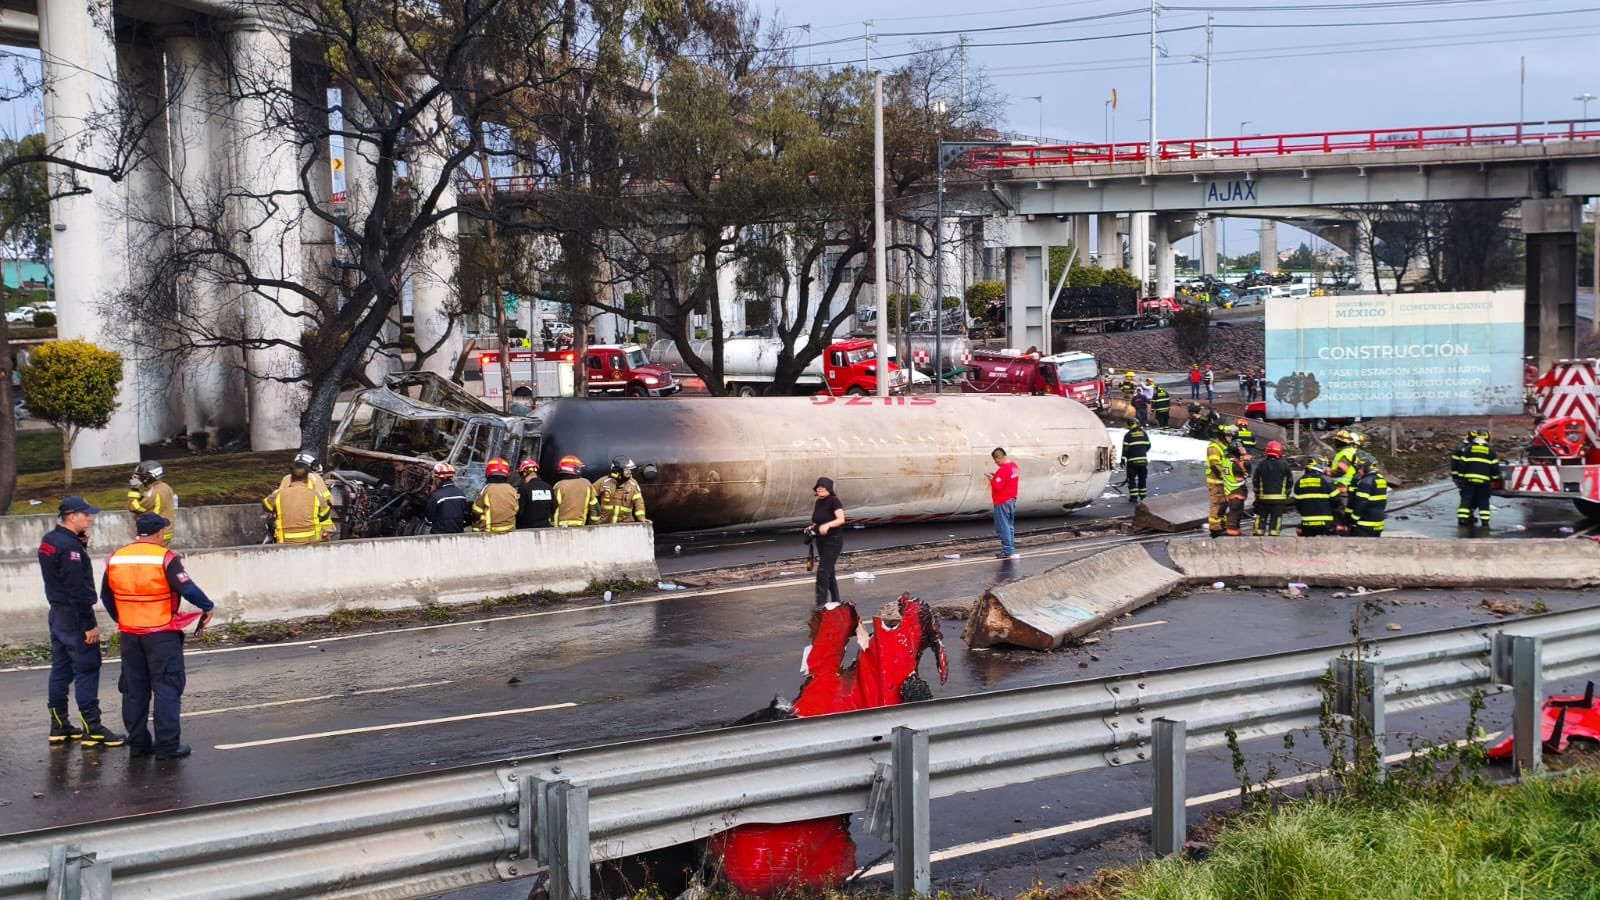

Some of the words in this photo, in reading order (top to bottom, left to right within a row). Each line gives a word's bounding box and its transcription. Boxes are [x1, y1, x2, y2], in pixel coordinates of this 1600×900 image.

[1208, 181, 1256, 201] AJAX
[1336, 307, 1386, 318] MÉXICO
[1318, 340, 1468, 359] CONSTRUCCIÓN
